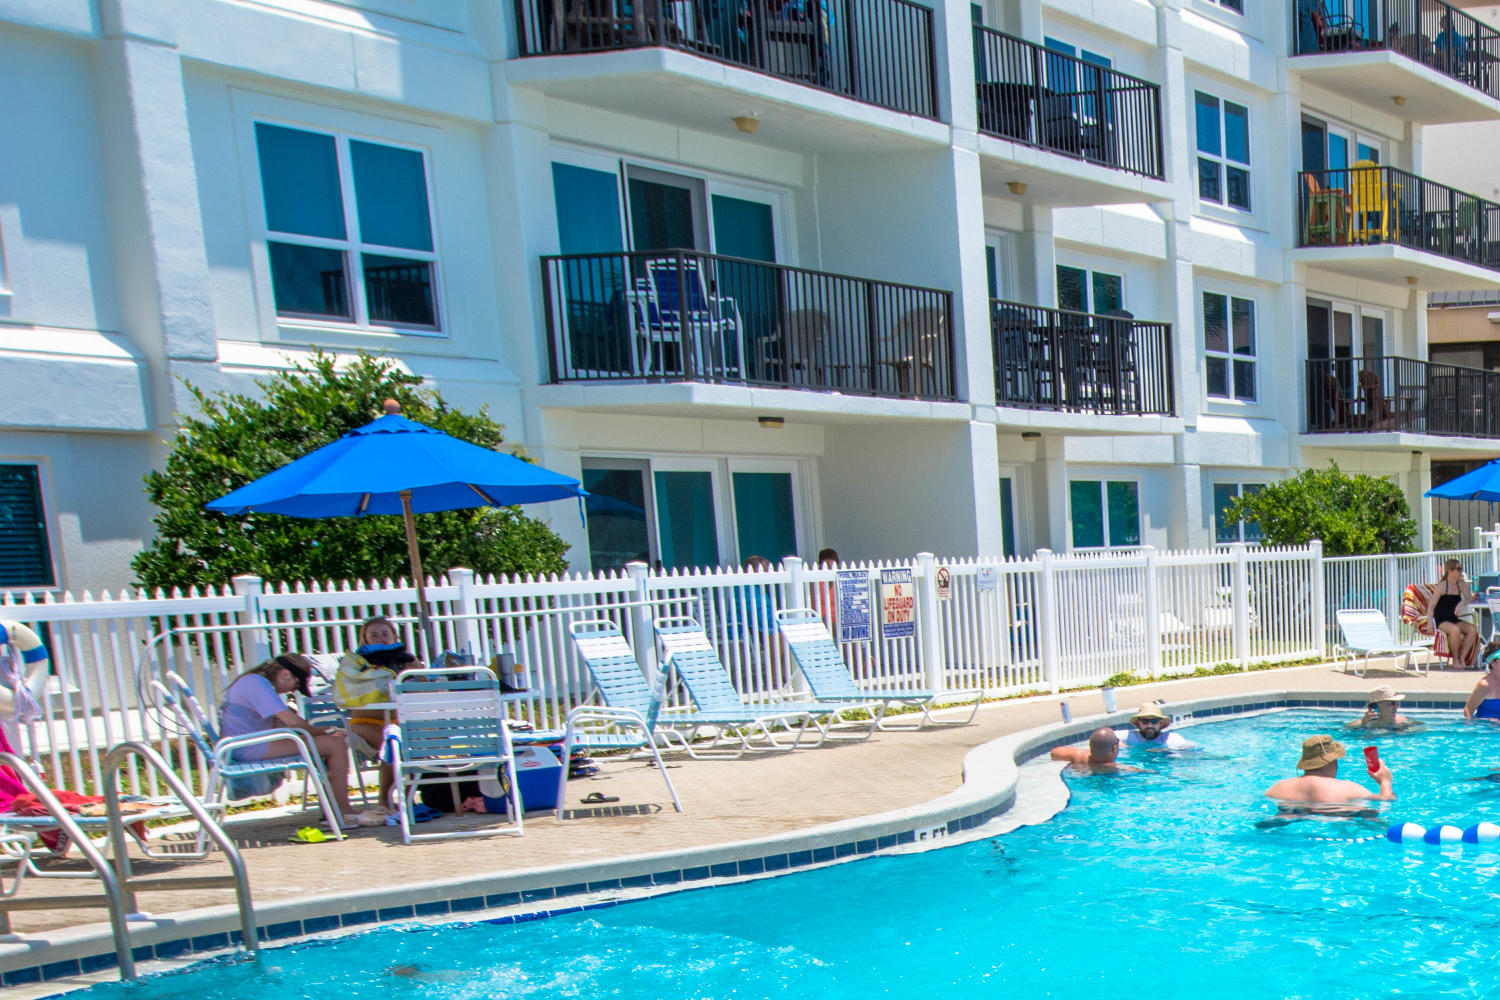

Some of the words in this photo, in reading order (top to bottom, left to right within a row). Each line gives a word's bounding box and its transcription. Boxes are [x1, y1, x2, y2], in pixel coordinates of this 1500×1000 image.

[881, 571, 912, 584] WARNING
[894, 584, 903, 597] NO
[884, 596, 913, 610] LIFEGUARD
[887, 611, 895, 623] ON
[896, 610, 910, 622] DUTY
[842, 627, 850, 640] NO
[850, 625, 869, 640] DIVING
[932, 826, 946, 838] FT
